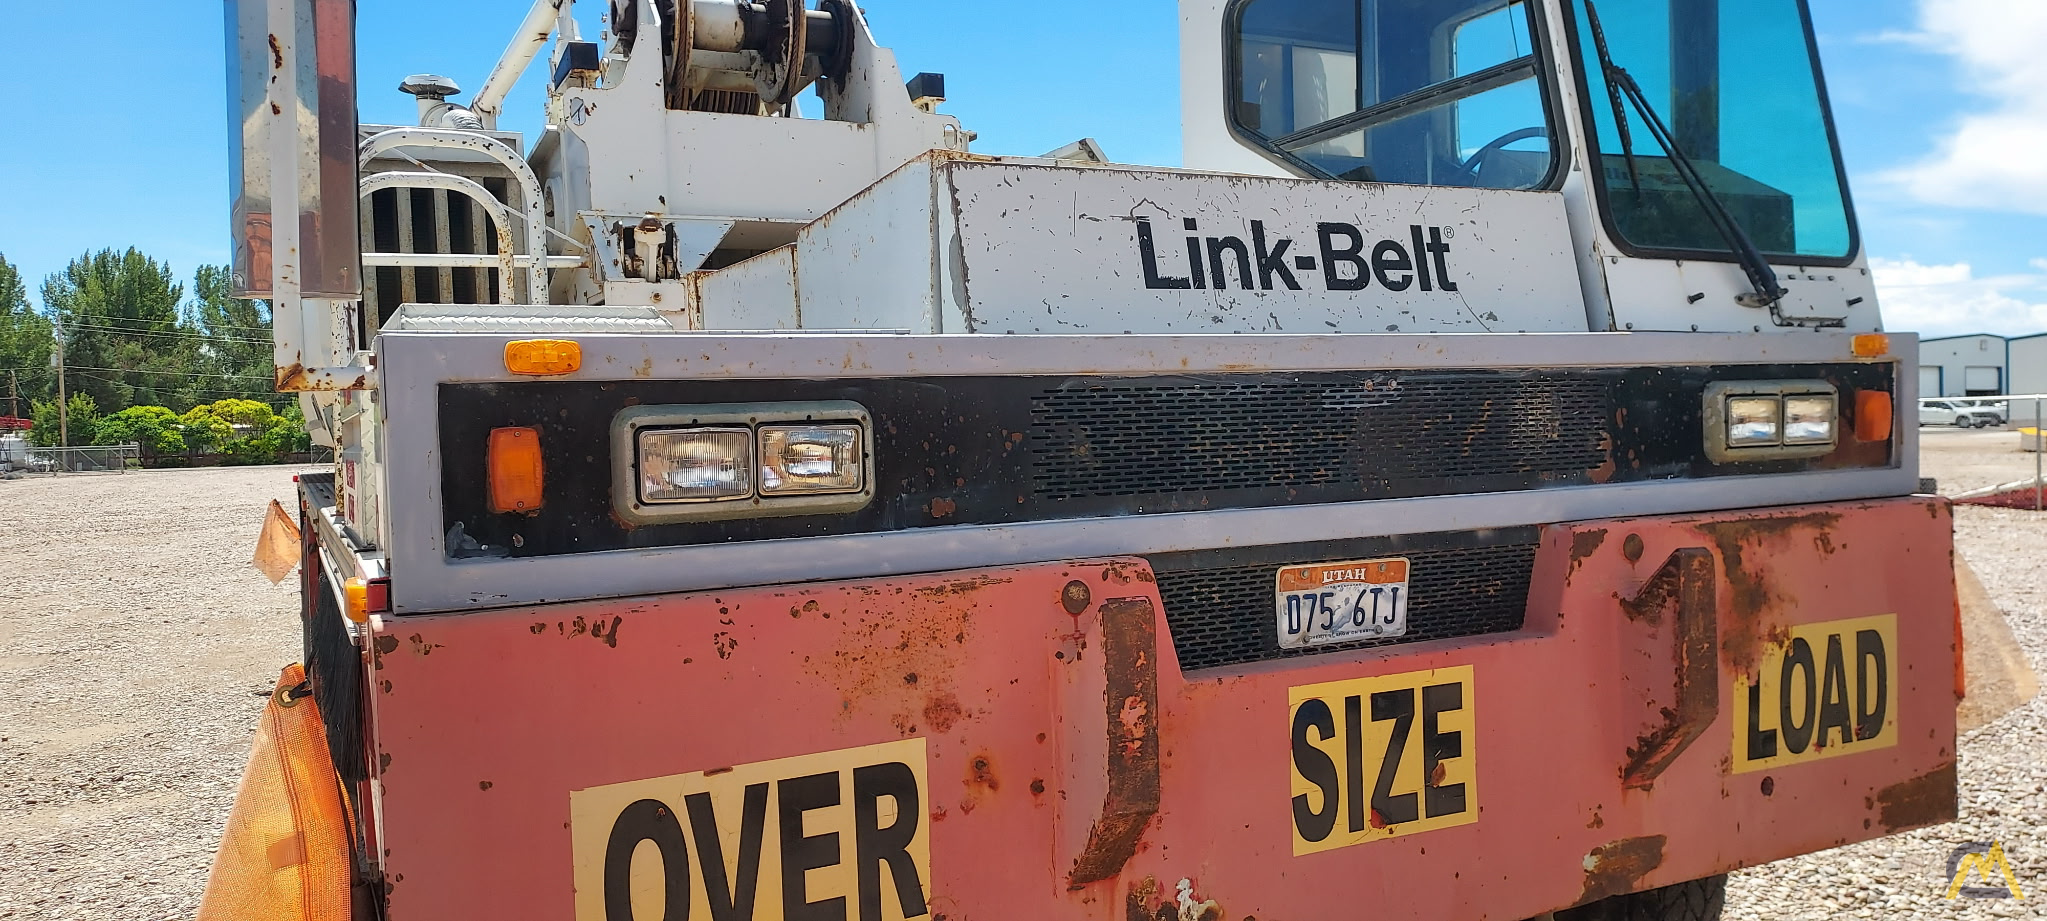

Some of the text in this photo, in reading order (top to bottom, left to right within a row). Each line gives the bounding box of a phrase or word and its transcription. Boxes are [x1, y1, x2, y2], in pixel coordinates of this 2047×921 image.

[1322, 568, 1366, 583] UTAH
[604, 629, 1888, 921] OVER SIZE LOAD
